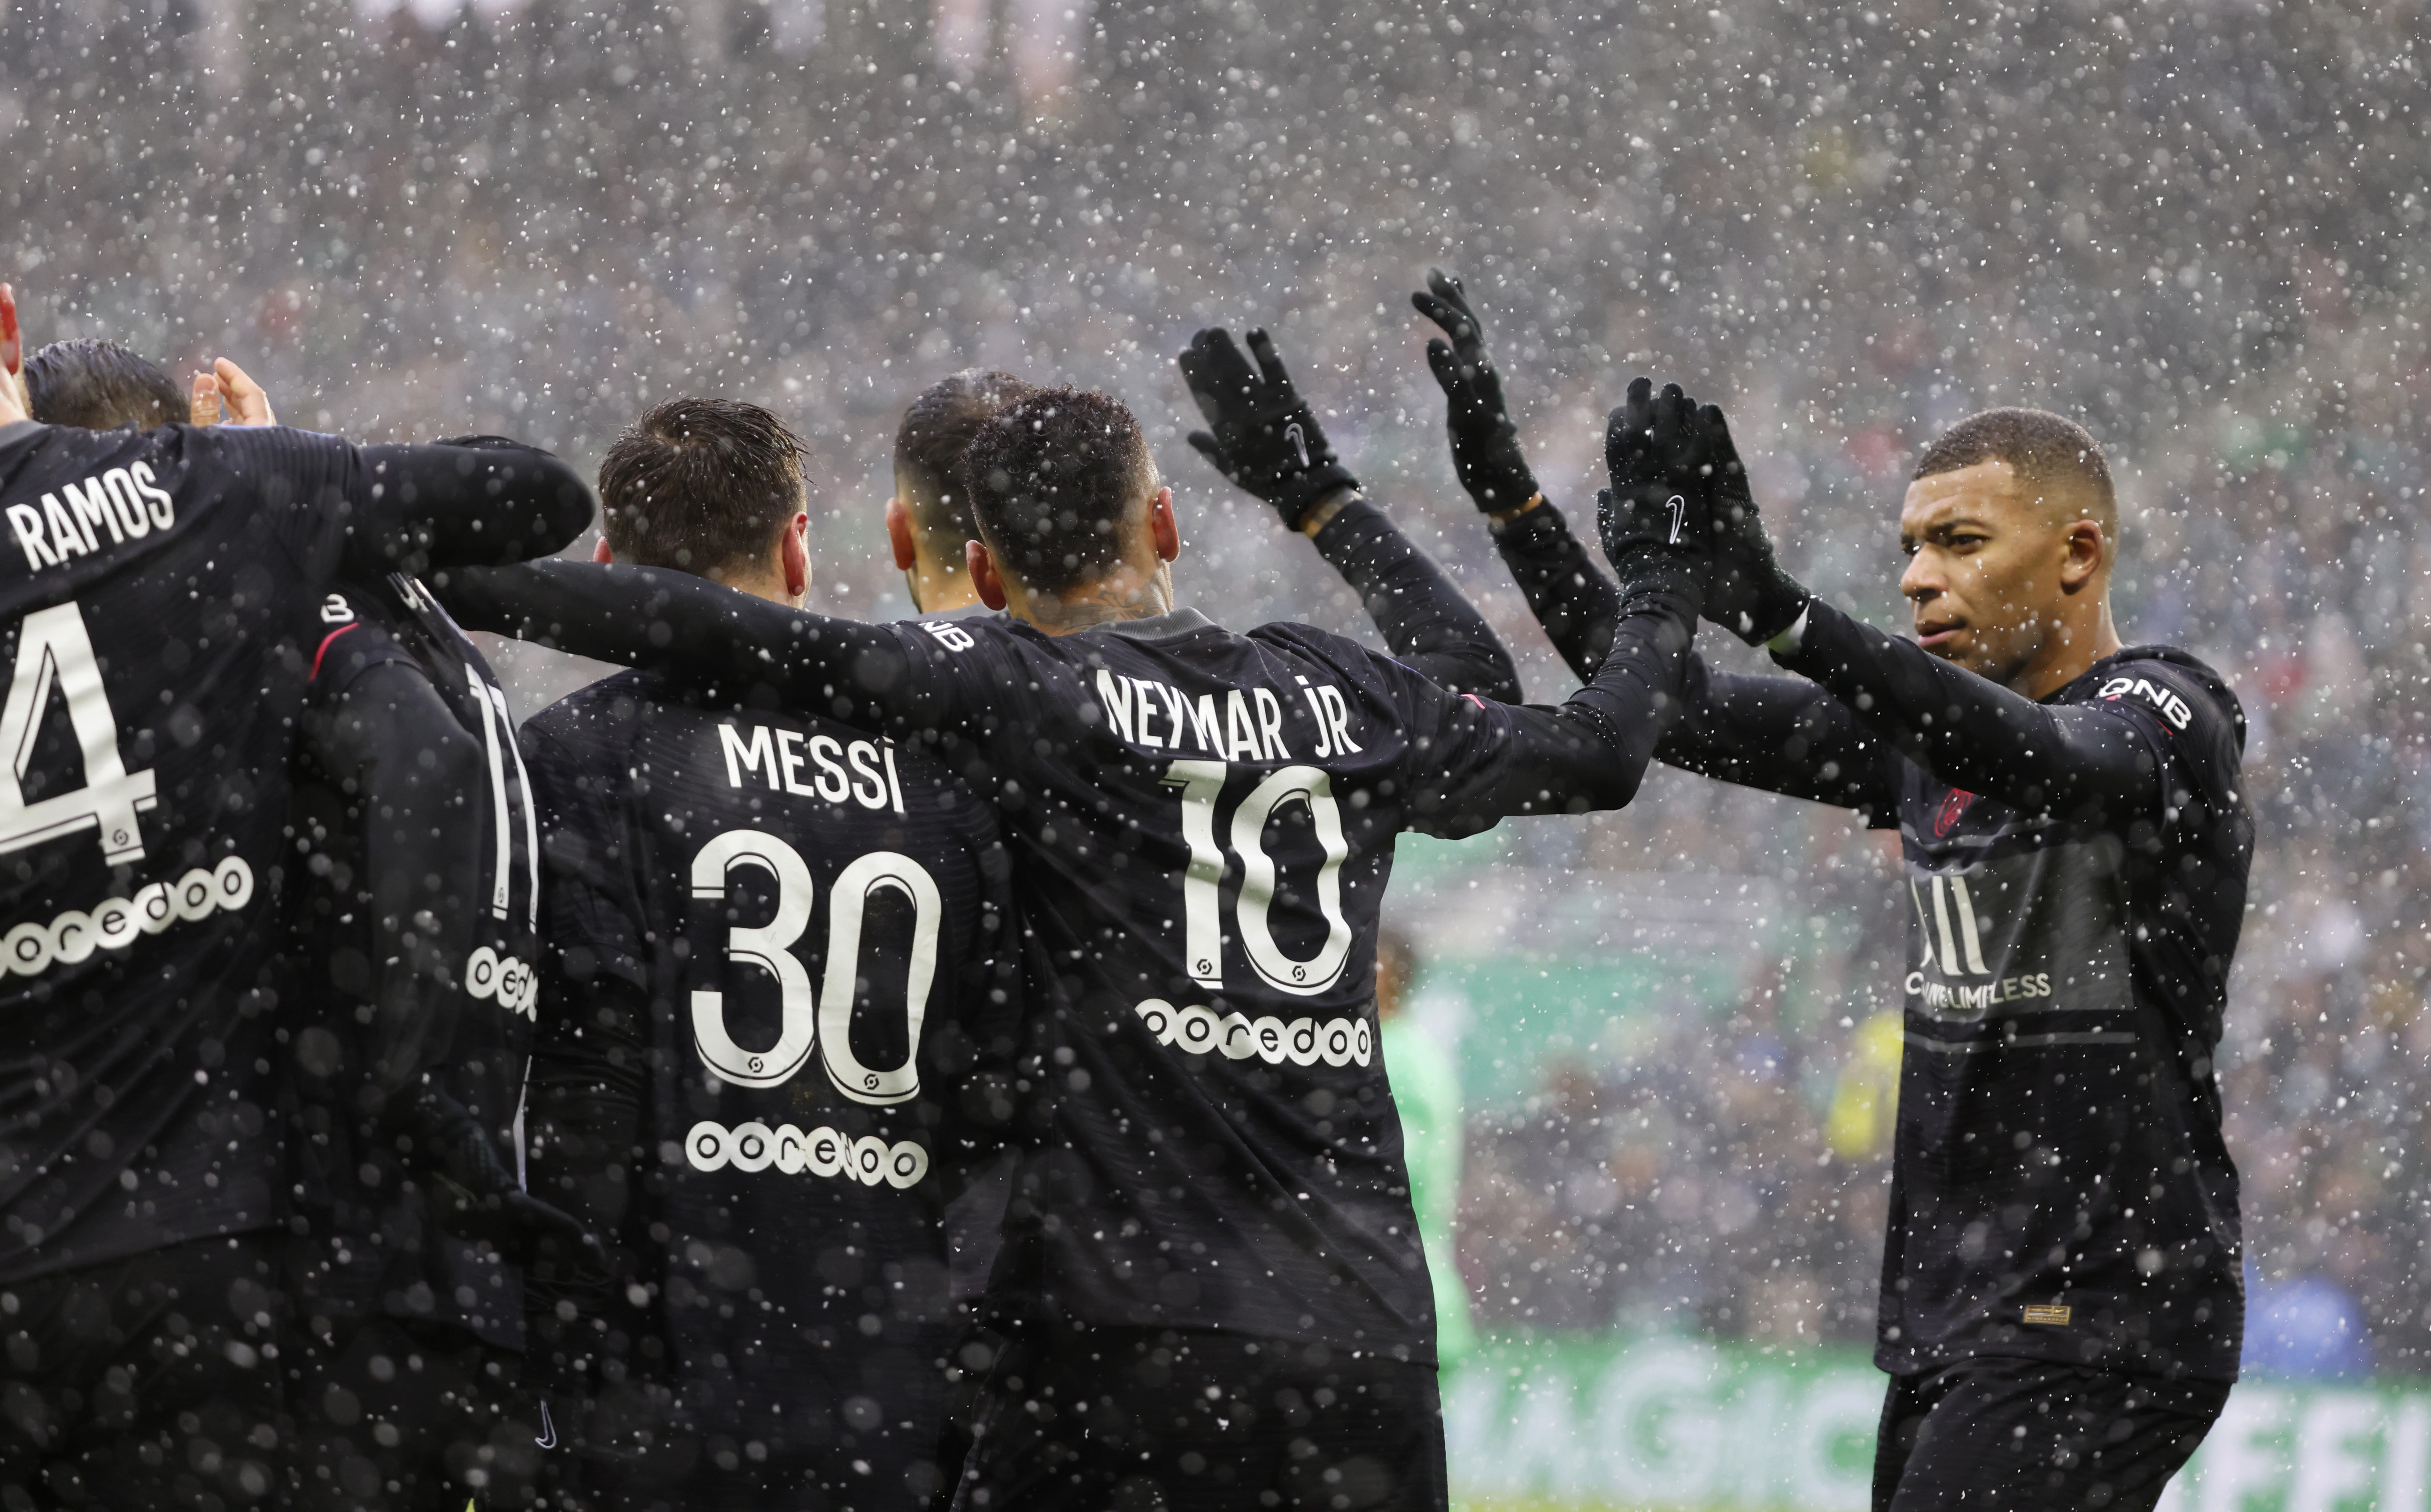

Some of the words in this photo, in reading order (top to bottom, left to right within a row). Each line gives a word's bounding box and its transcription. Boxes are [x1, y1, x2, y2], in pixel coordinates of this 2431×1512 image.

[5, 461, 174, 571] RAMOS
[918, 621, 975, 651] NB
[0, 601, 157, 867] 4
[1097, 670, 1292, 761] NEYMAR
[2098, 678, 2192, 730] QNB
[718, 724, 905, 813] MESSI
[0, 856, 254, 981] oredoo
[1158, 759, 1352, 996] 10
[691, 829, 942, 1105] 30
[1135, 998, 1372, 1067] ooredoo
